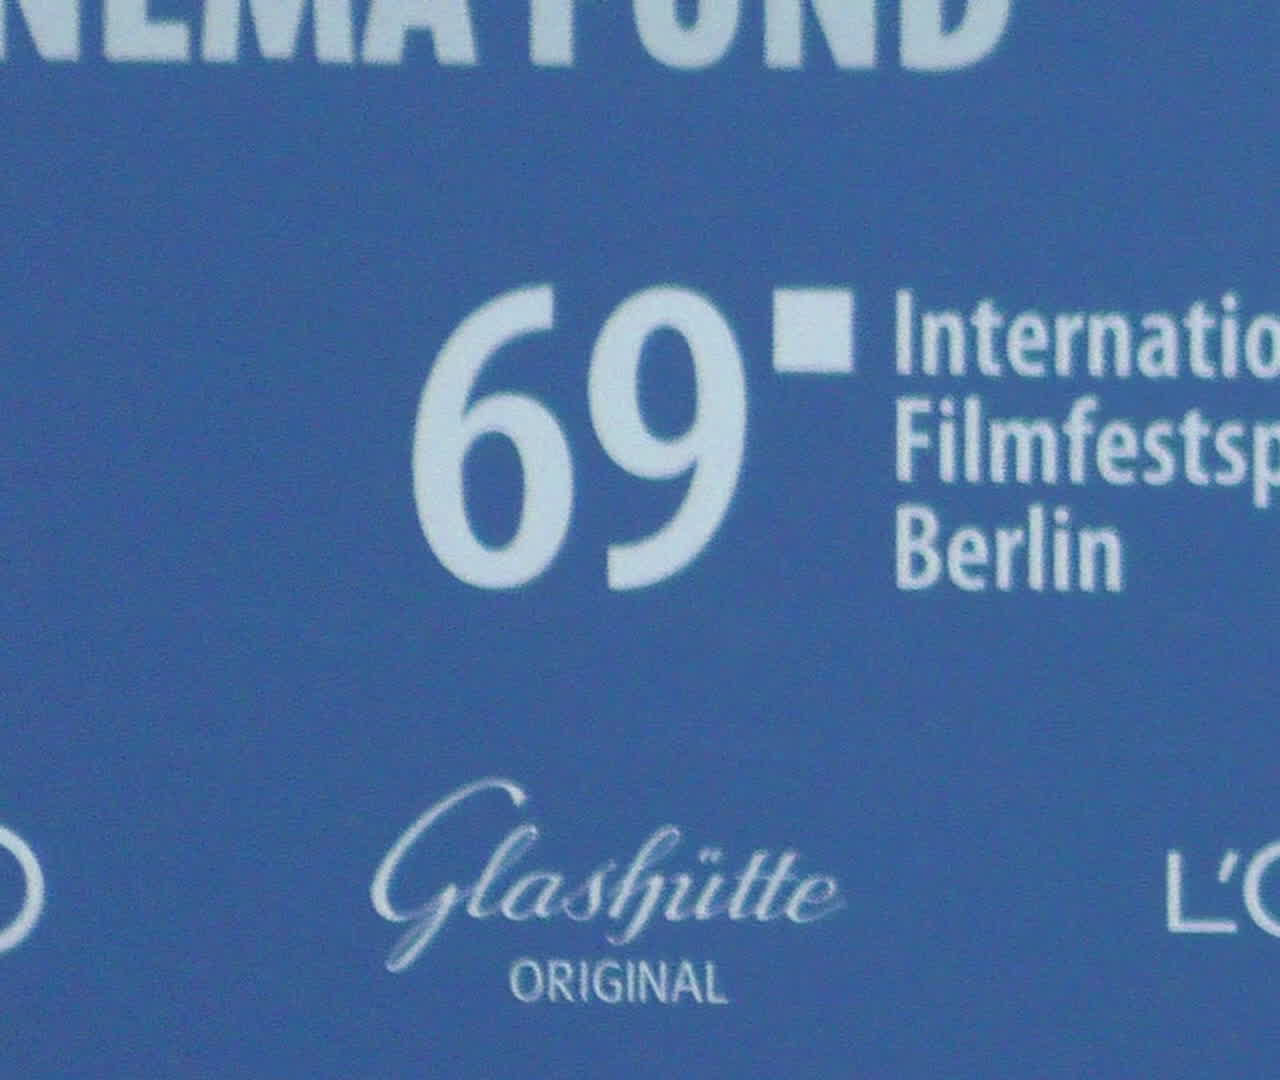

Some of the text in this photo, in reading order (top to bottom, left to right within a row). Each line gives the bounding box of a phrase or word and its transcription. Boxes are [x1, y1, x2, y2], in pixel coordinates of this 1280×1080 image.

[412, 285, 747, 590] 69
[896, 505, 1121, 591] Berlin
[370, 777, 846, 973] Glashütte
[510, 959, 727, 1003] ORIGINAL
